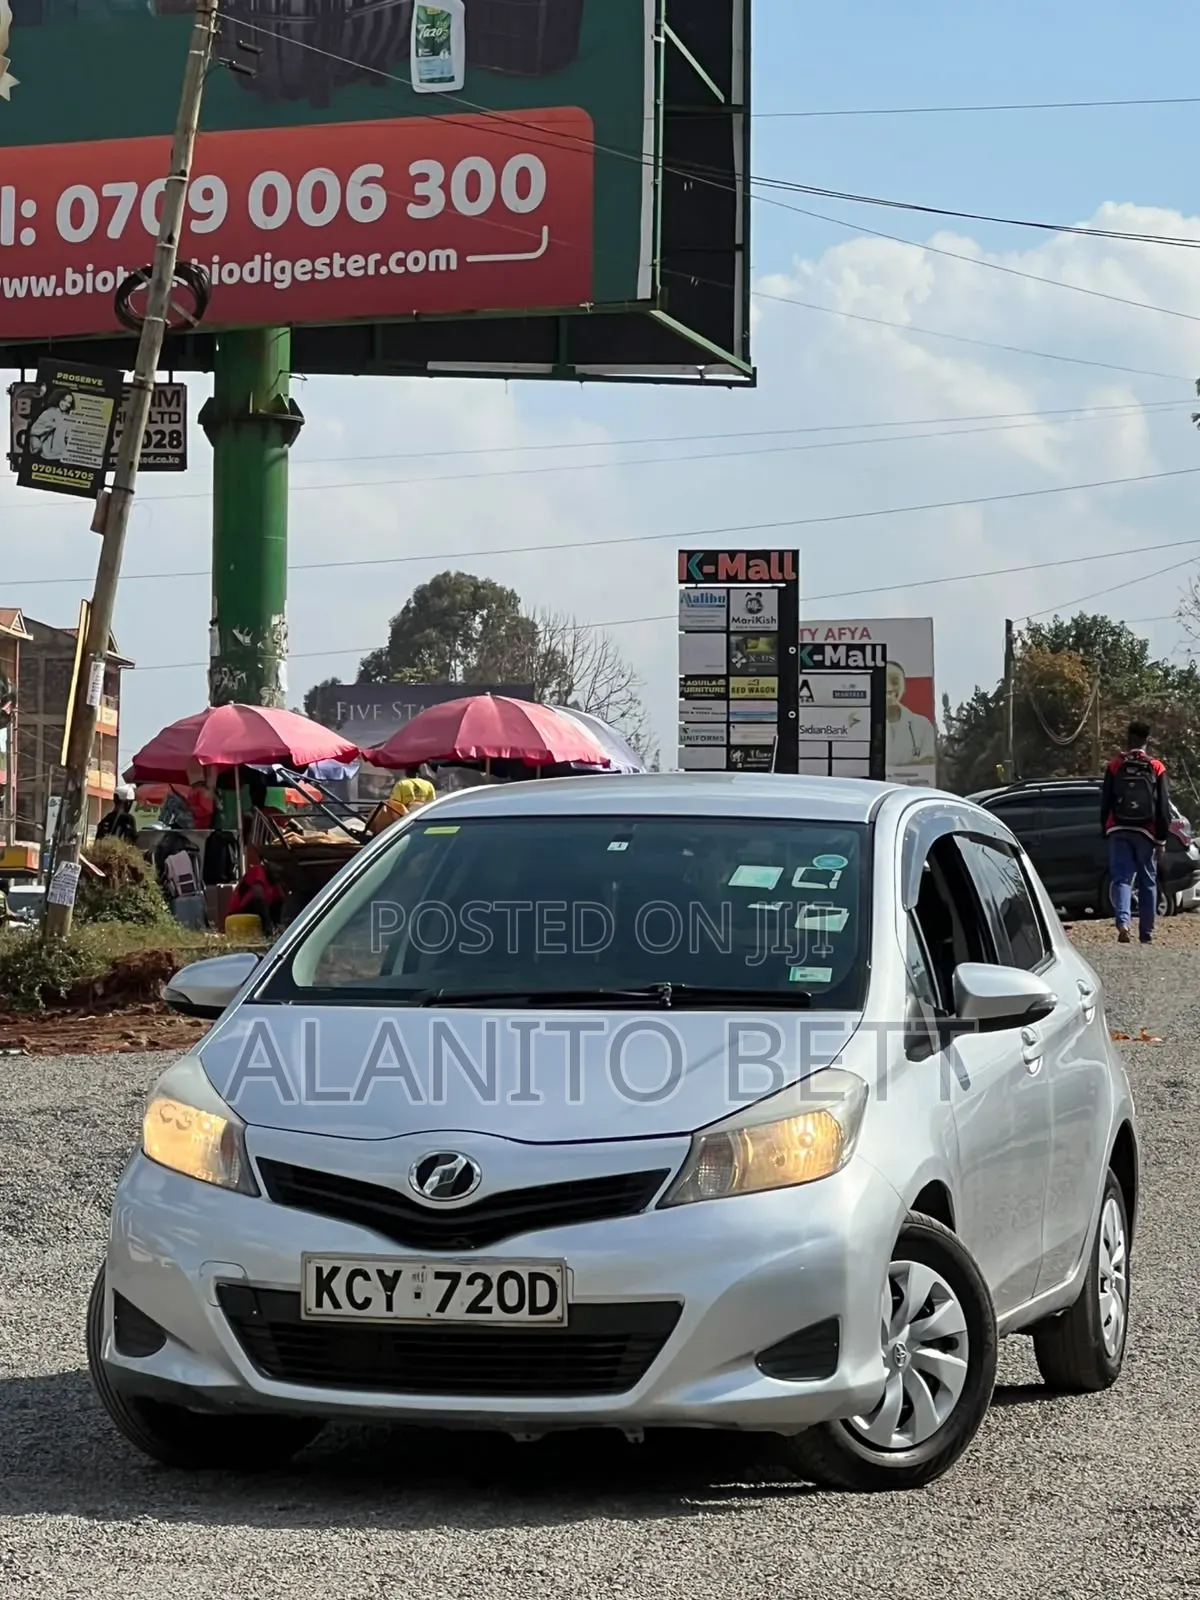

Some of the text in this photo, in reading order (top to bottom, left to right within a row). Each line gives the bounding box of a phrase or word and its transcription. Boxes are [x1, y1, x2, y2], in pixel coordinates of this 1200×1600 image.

[248, 163, 387, 230] 006
[406, 153, 547, 219] 300
[31, 463, 94, 481] 0701414705
[678, 551, 797, 580] K-Mall
[824, 626, 872, 641] AFYA
[336, 701, 382, 721] FIVE
[314, 1265, 558, 1315] KCY 720D
